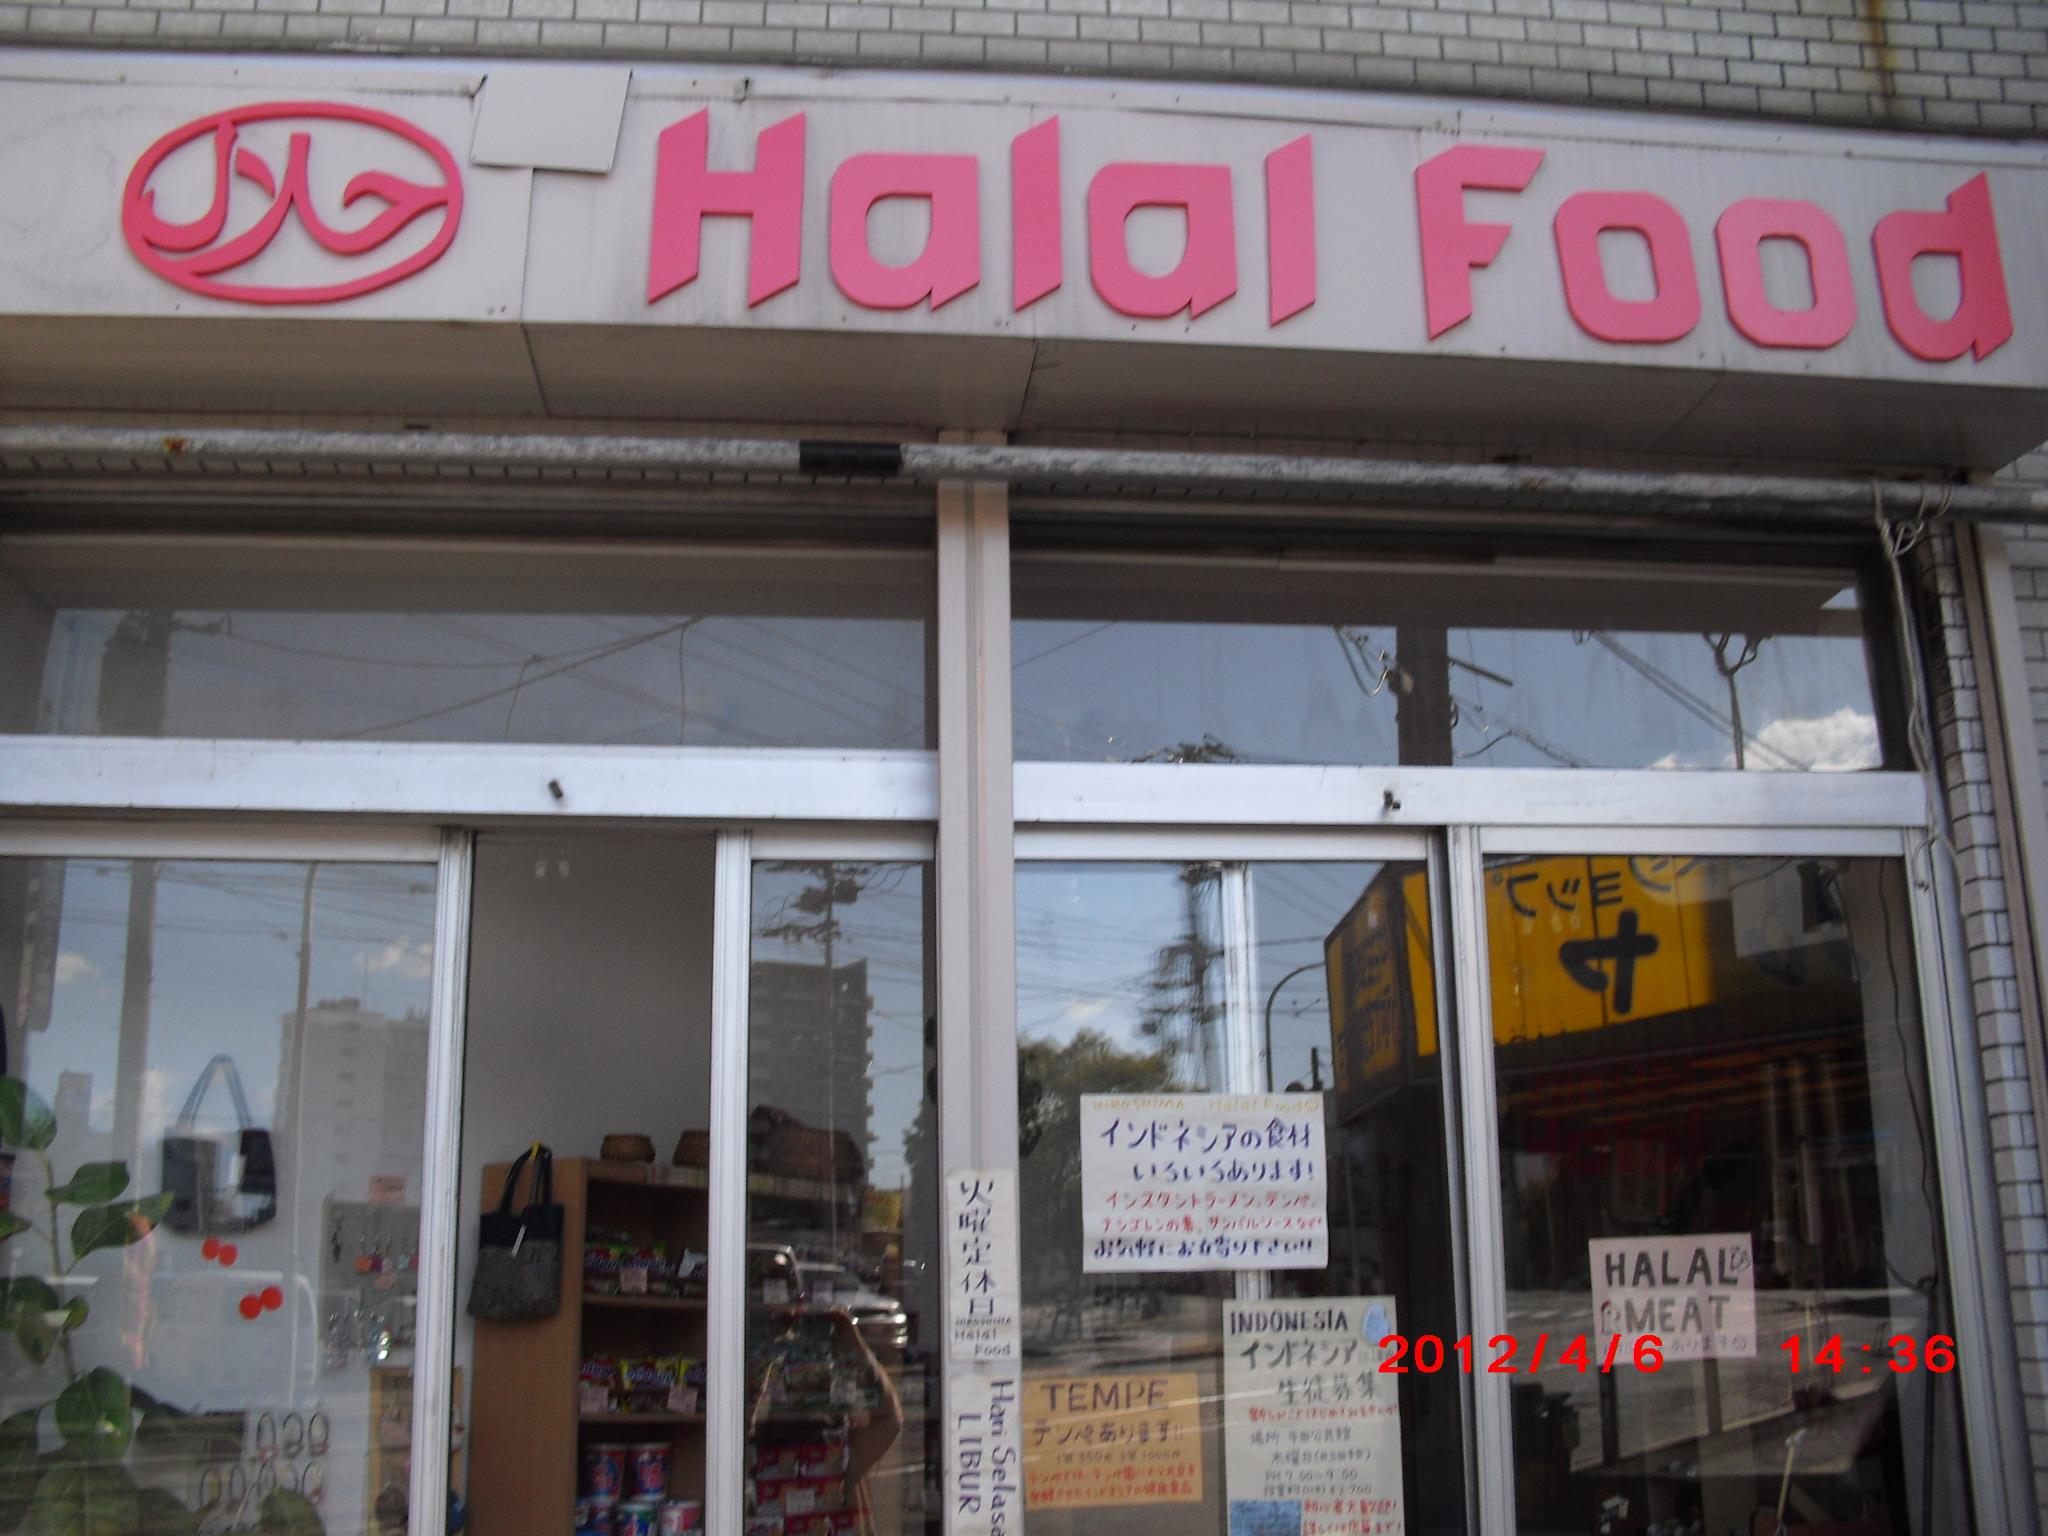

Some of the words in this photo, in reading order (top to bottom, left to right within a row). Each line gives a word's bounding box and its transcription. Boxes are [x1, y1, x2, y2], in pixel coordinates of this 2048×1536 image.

[138, 116, 453, 284] حلال
[646, 108, 1316, 327] Halal
[1414, 144, 2015, 362] Food
[1098, 1116, 1311, 1154] インドネシアの食材
[958, 1178, 998, 1316] 火曜定休日
[1604, 1246, 1739, 1288] HALAL
[1230, 1307, 1349, 1335] INDONESIA
[1624, 1294, 1731, 1334] MEAT
[954, 1328, 998, 1343] Halal
[973, 1342, 1012, 1358] Food
[989, 1380, 1015, 1438] Hari
[1039, 1378, 1170, 1413] TEMPE
[958, 1413, 983, 1515] LIBUR
